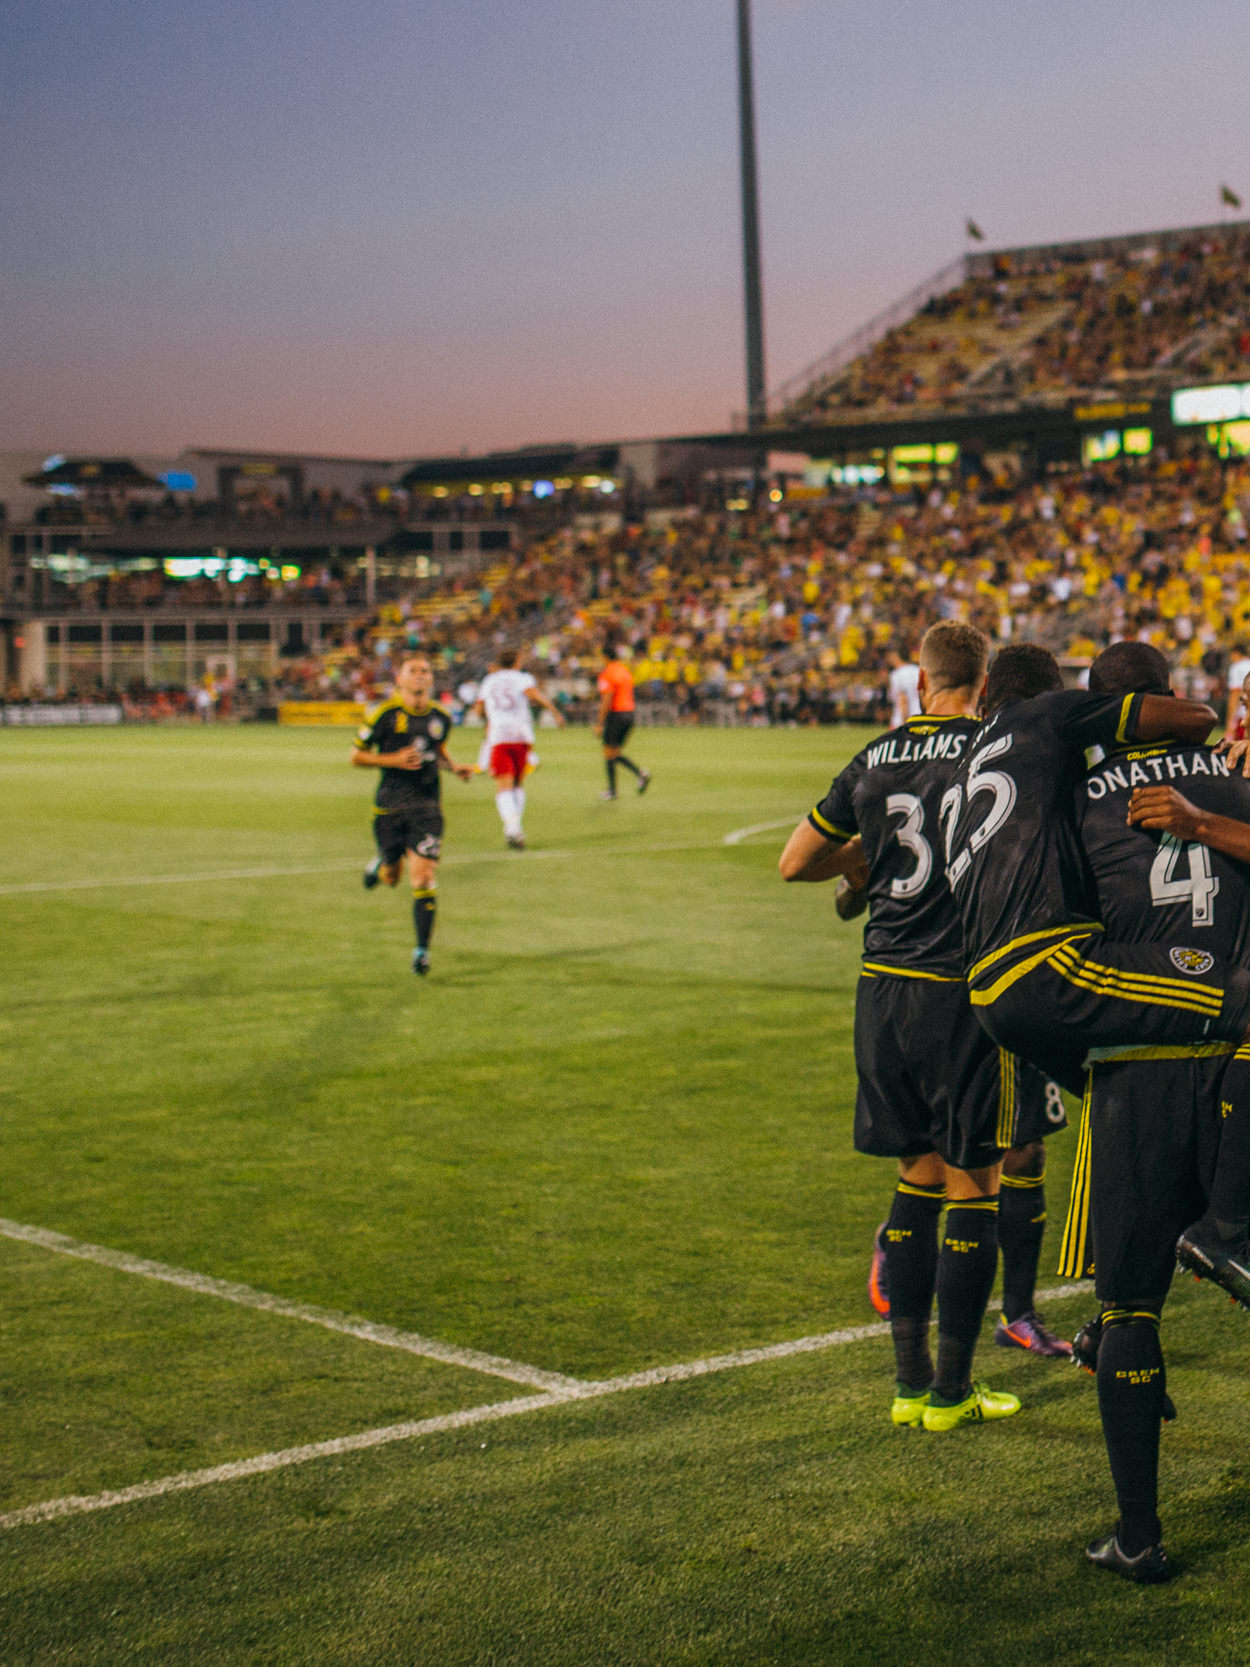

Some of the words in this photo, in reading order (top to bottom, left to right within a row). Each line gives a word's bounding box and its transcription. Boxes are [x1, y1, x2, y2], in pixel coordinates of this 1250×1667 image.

[867, 733, 968, 769] WILLIAMS
[1087, 753, 1230, 799] ONATHAN
[885, 793, 933, 899] 3
[1150, 830, 1220, 928] 4
[1045, 1081, 1065, 1124] 8
